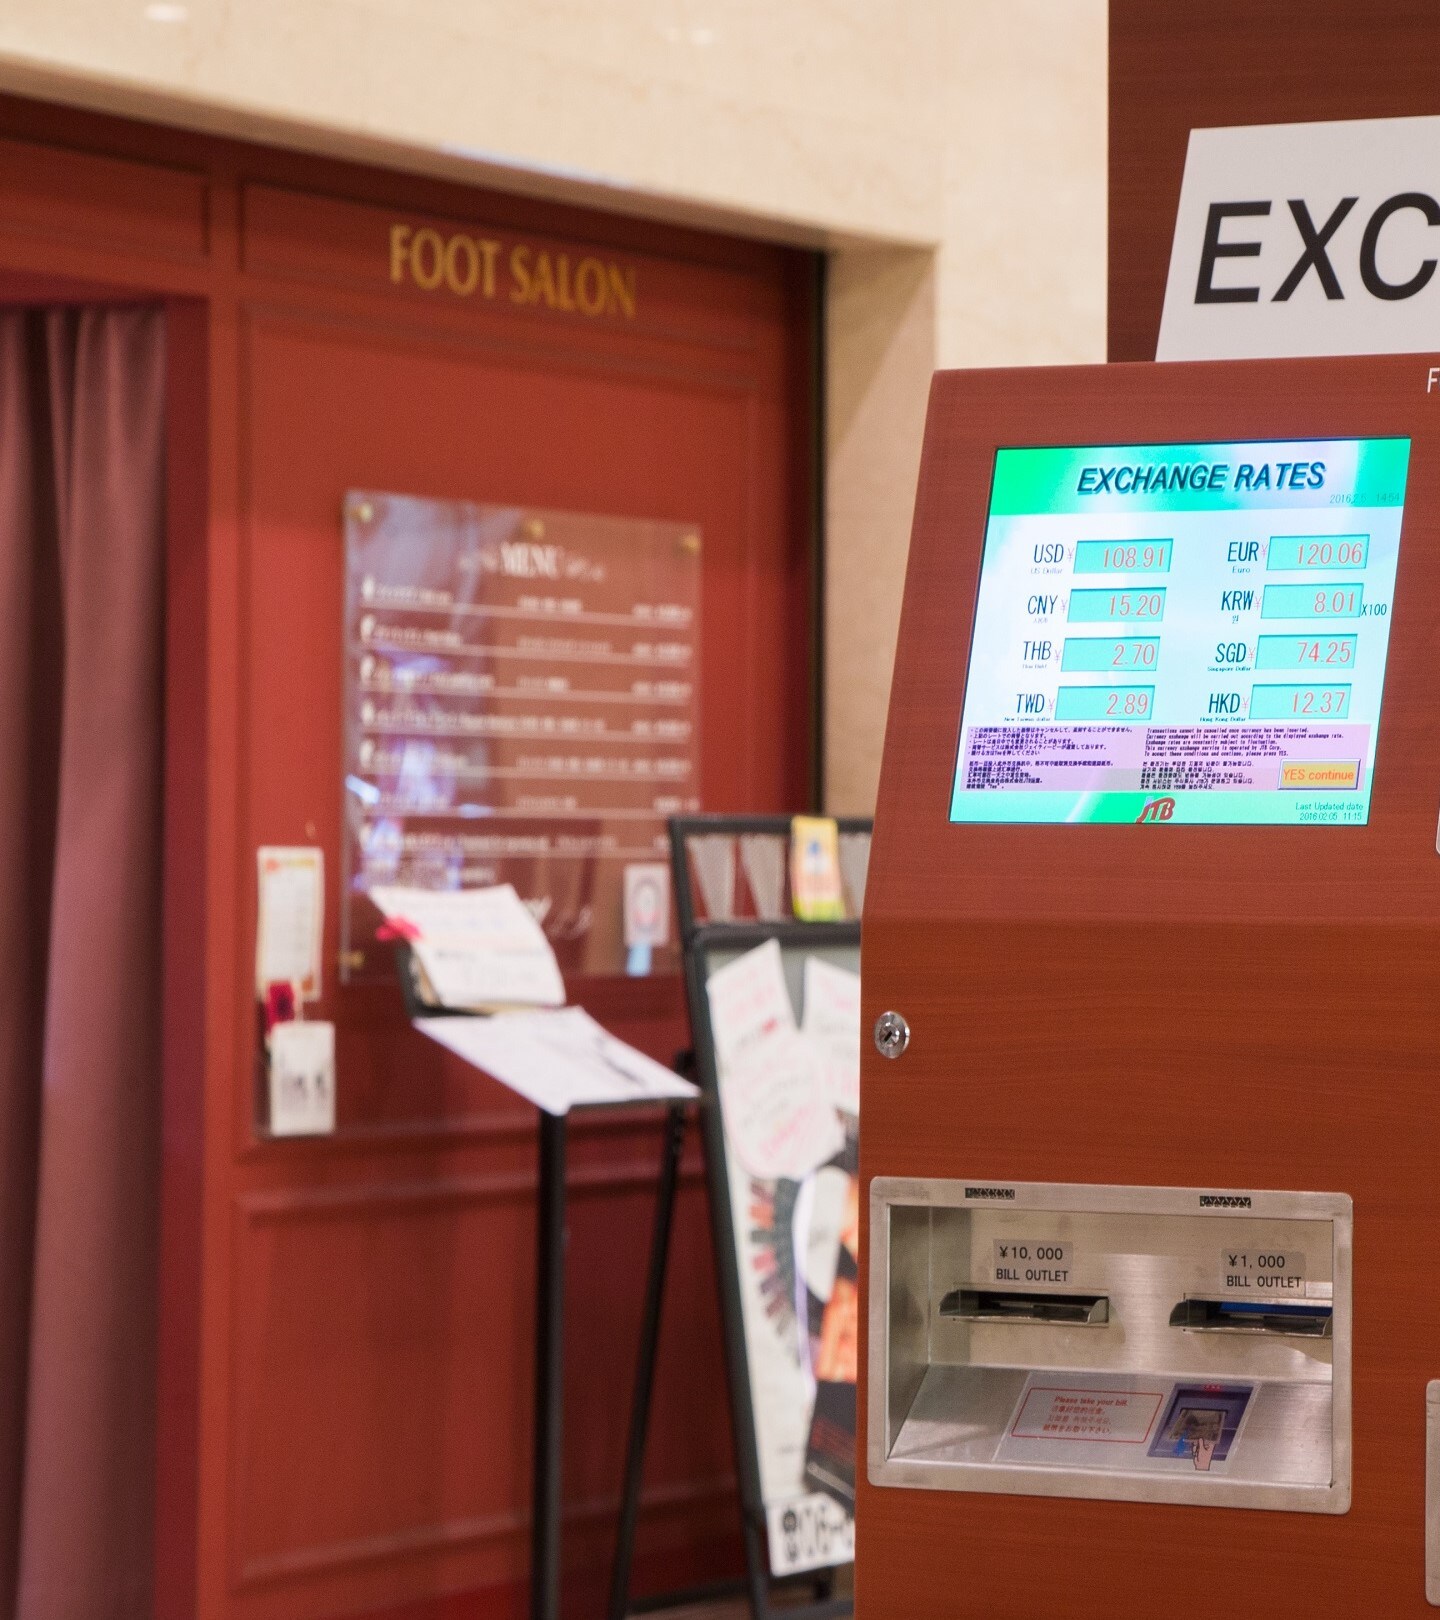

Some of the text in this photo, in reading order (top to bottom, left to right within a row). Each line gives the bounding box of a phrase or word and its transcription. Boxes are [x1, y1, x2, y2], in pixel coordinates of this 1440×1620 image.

[390, 224, 636, 321] FOOT SALON
[1077, 462, 1326, 494] EXCHANGE RATES
[1033, 543, 1064, 563] USD
[1103, 546, 1164, 568] 108.91
[1227, 541, 1259, 562] EUR
[1297, 542, 1363, 565] 120.06
[1027, 595, 1058, 615] CNY
[1110, 594, 1161, 616] 15.20
[1221, 590, 1254, 611] KRW
[1314, 591, 1354, 613] 8.01
[1023, 640, 1051, 661] THB
[1113, 644, 1155, 665] 2.70
[1215, 642, 1247, 663] SGD
[1297, 641, 1351, 663] 74.25
[1016, 693, 1045, 713] TWD
[1106, 693, 1149, 715] 2.89
[1208, 693, 1240, 714] HKD
[1293, 691, 1346, 714] 12.37
[1283, 769, 1354, 780] YES continue
[1135, 797, 1176, 823] JTB
[1295, 802, 1363, 811] Last Updated date
[996, 1268, 1069, 1283] BILL OUTLET
[1226, 1275, 1302, 1289] BILL OUTLET
[1055, 1395, 1078, 1404] Please
